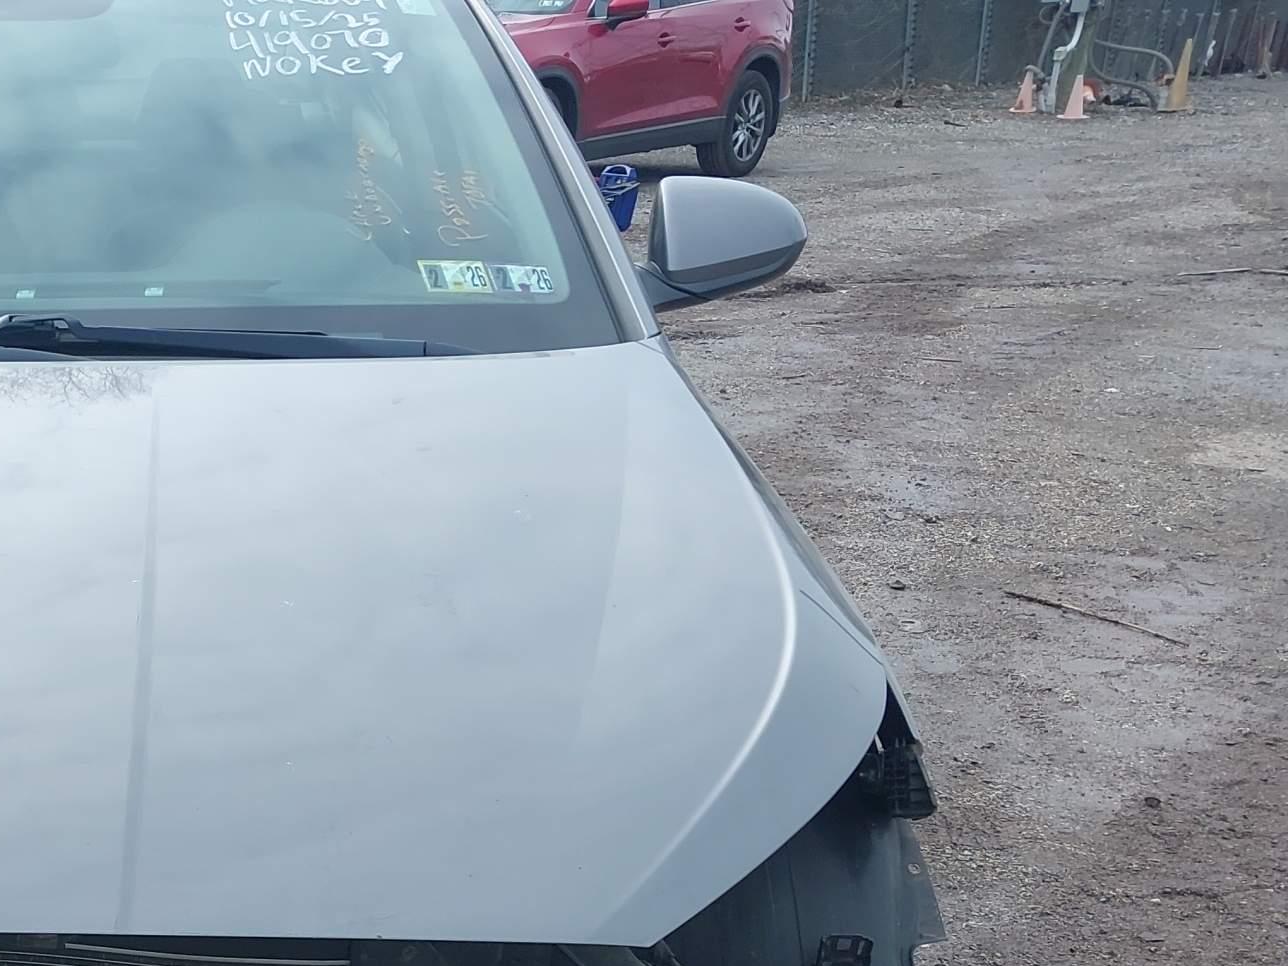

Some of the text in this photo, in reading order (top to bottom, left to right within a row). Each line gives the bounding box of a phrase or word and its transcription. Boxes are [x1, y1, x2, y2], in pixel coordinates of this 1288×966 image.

[225, 9, 381, 28] 10/15/25
[229, 28, 390, 57] 419070
[428, 265, 488, 289] 2 26
[532, 268, 554, 291] 26
